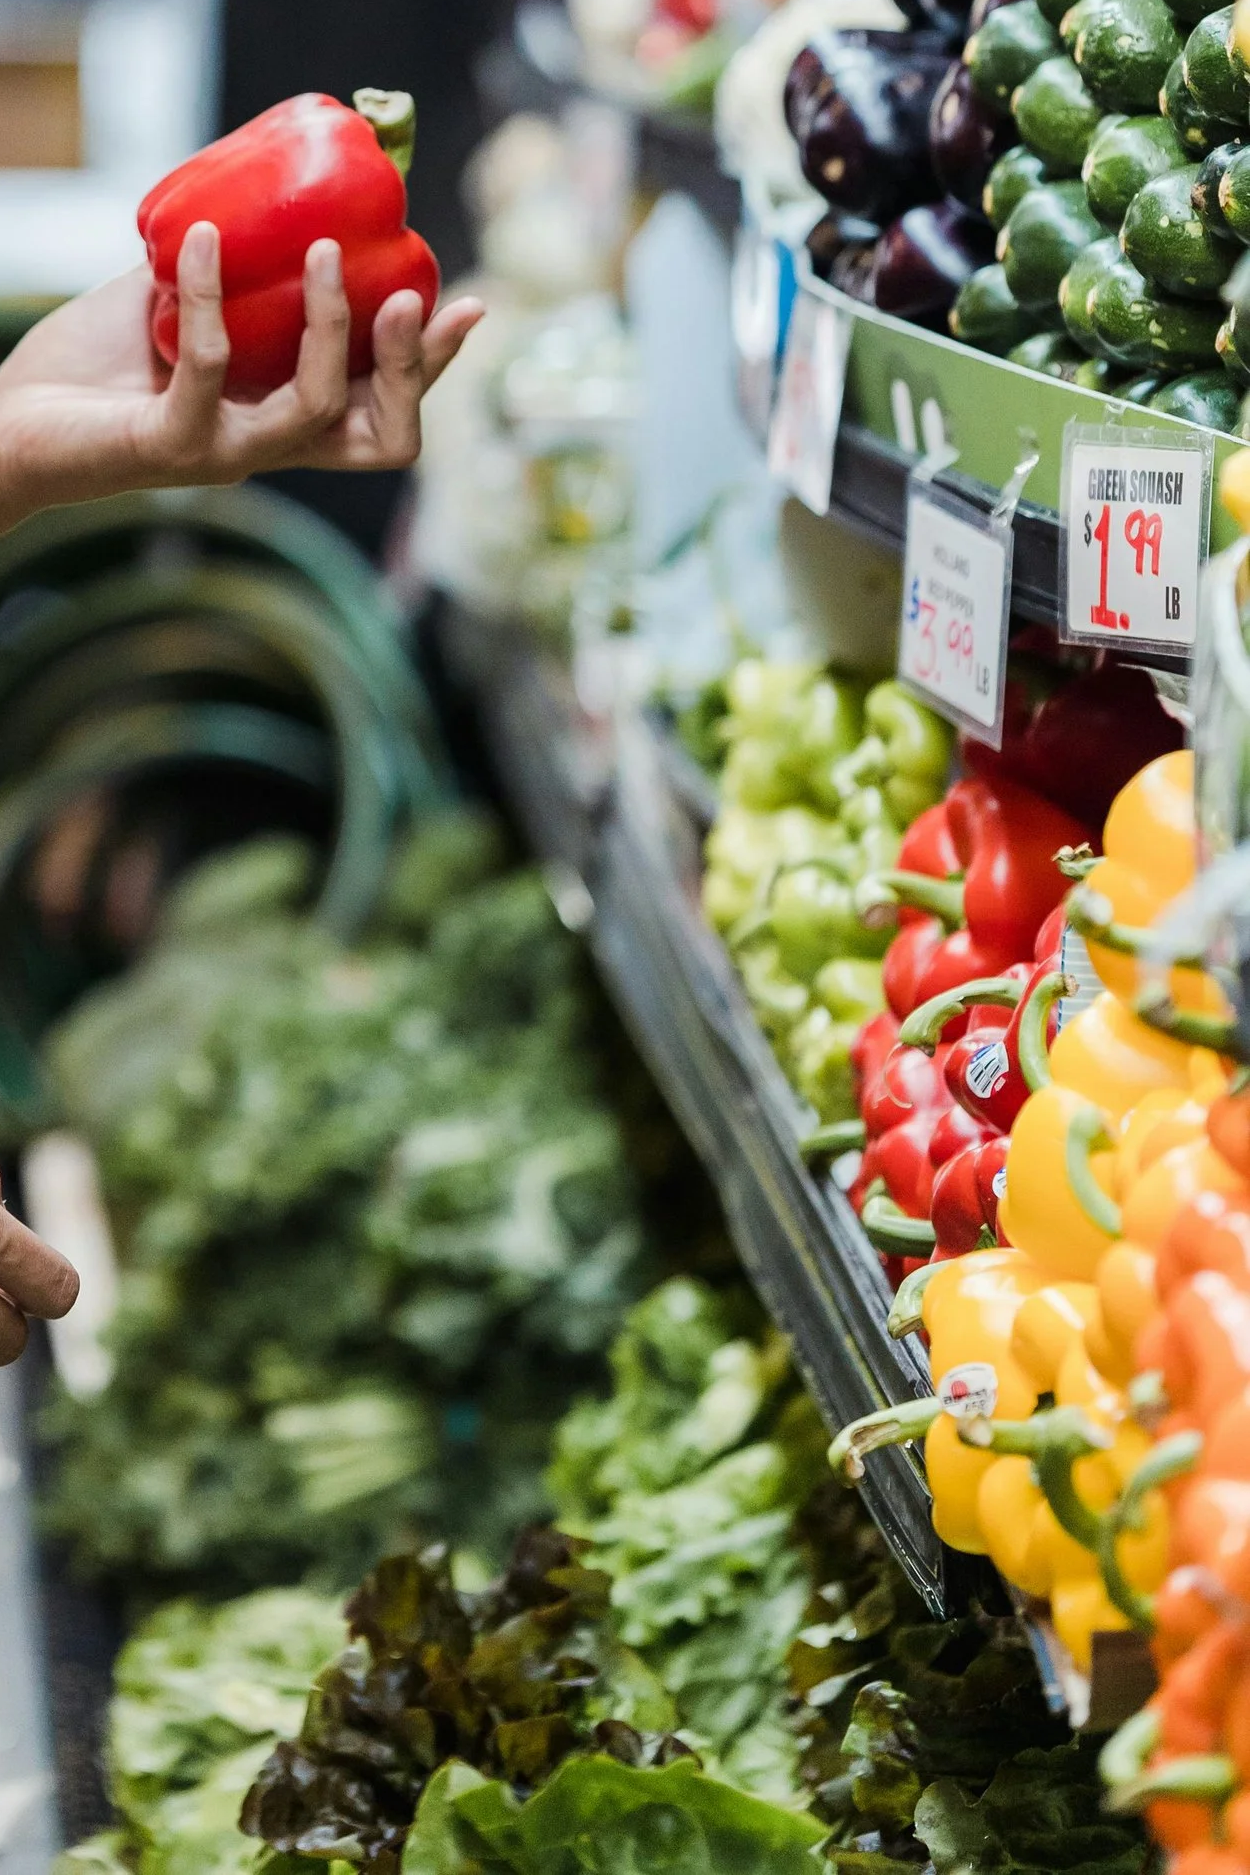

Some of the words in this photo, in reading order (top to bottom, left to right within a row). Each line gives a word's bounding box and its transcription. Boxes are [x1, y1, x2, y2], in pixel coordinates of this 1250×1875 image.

[1088, 467, 1127, 502] GREEN
[1130, 469, 1184, 505] SQUASH
[1165, 586, 1180, 620] LB
[975, 662, 990, 696] LB
